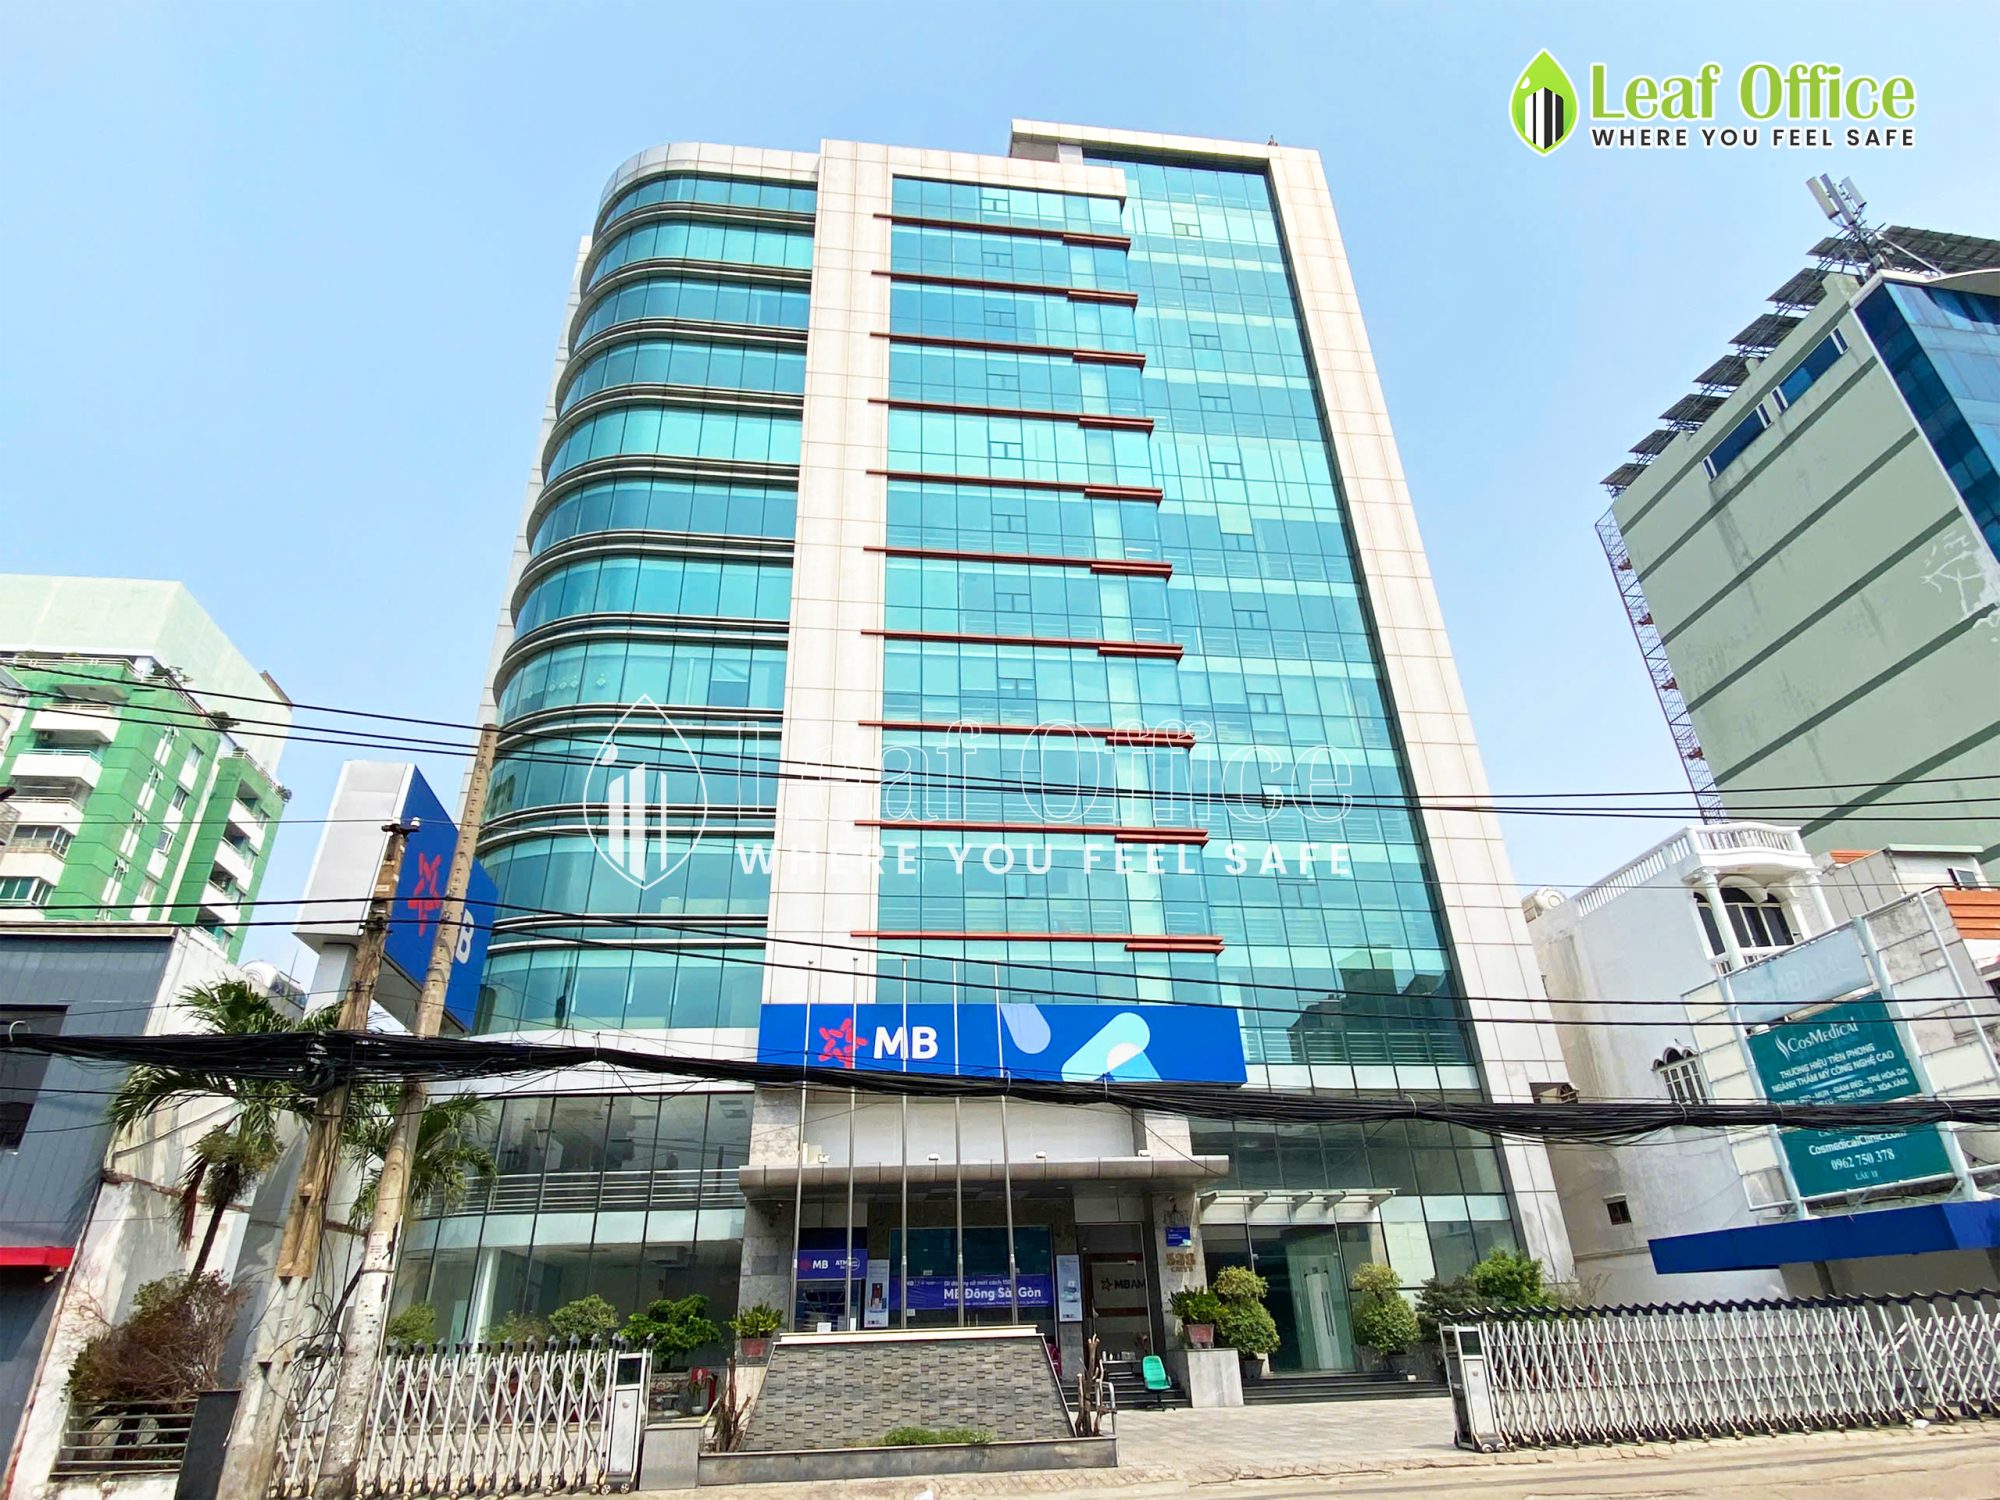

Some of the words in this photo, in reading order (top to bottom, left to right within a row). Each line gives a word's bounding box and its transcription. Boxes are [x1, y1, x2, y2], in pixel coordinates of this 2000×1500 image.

[873, 1025, 939, 1060] MB
[1876, 1050, 1895, 1062] CAO
[1830, 1156, 1855, 1171] 0962
[1855, 1152, 1874, 1166] 750
[1875, 1148, 1895, 1163] 378
[812, 1259, 829, 1269] MB
[965, 1287, 995, 1301] Đông
[997, 1286, 1013, 1298] Sà
[1018, 1286, 1042, 1298] Gòn
